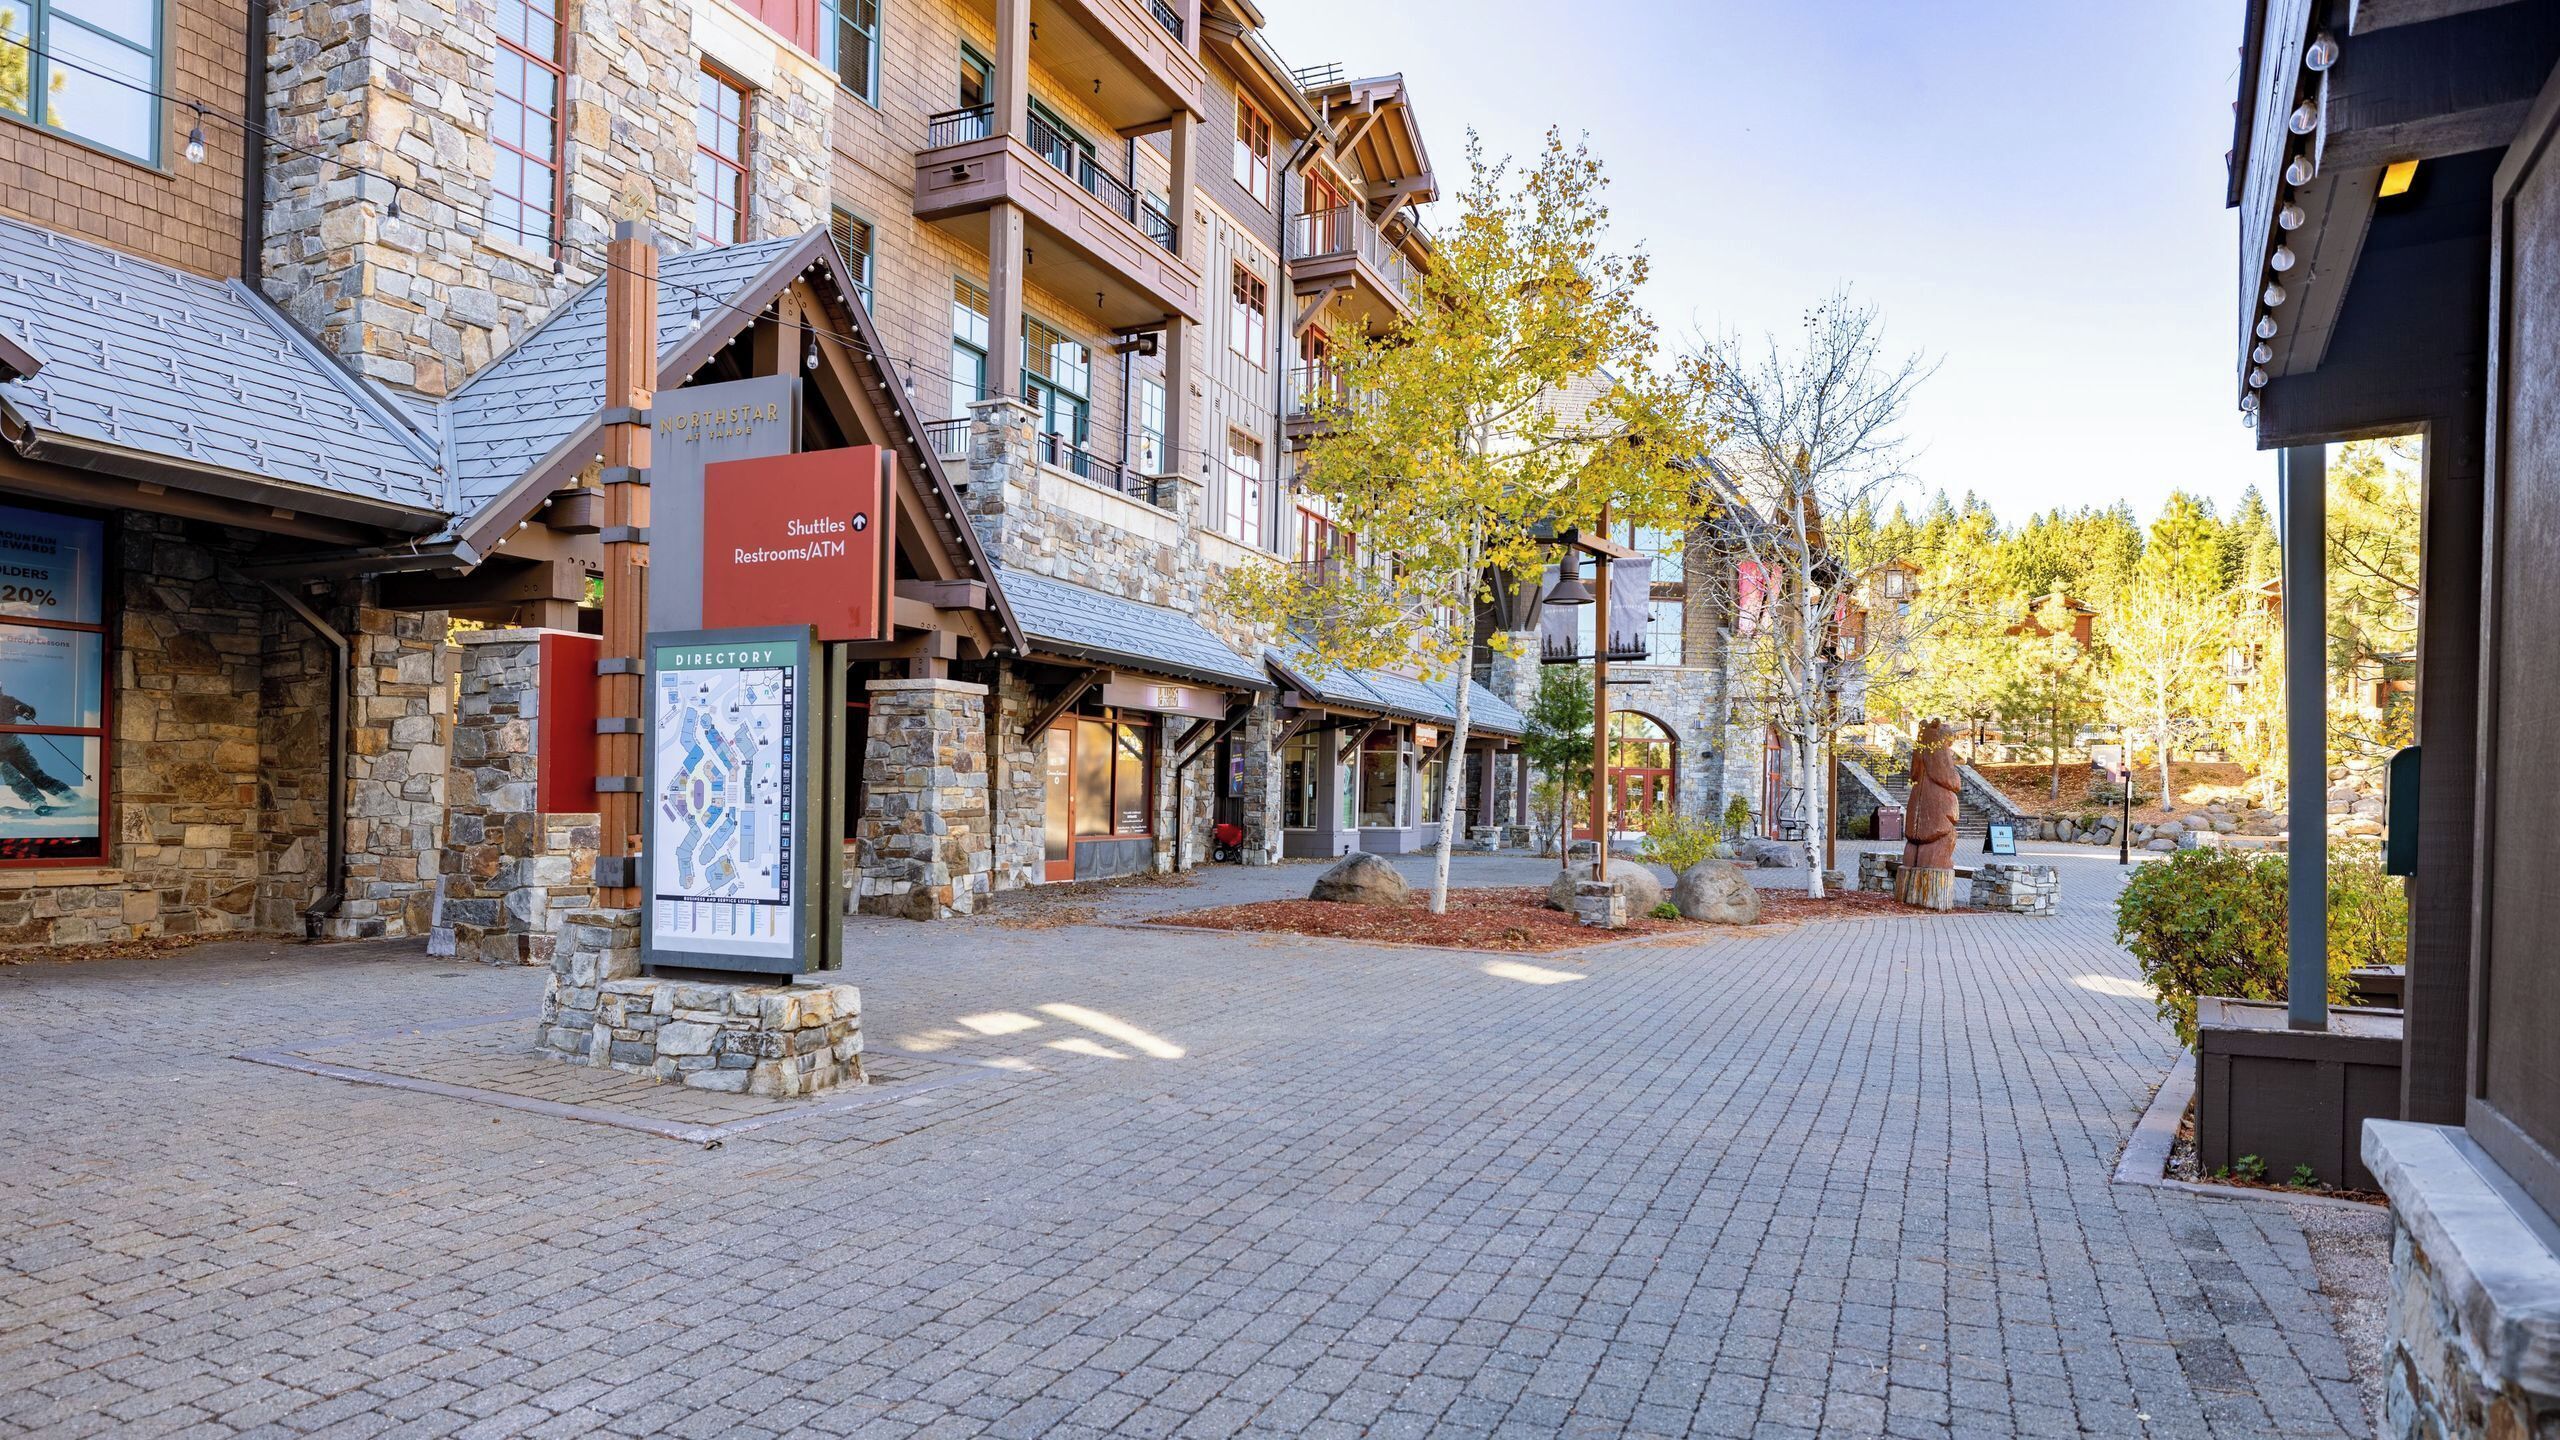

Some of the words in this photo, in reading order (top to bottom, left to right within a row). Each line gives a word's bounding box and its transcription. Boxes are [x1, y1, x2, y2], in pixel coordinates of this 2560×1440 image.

[660, 403, 778, 437] NORTHSTAR
[686, 432, 701, 443] AT
[709, 426, 752, 440] TAHOE
[787, 516, 846, 536] Shuttles
[0, 539, 57, 554] EWARDS
[734, 540, 845, 564] Restrooms/ATM
[0, 565, 49, 580] LDERS
[2, 584, 57, 606] 20%
[676, 650, 772, 666] DIRECTORY
[2097, 755, 2106, 767] 5
